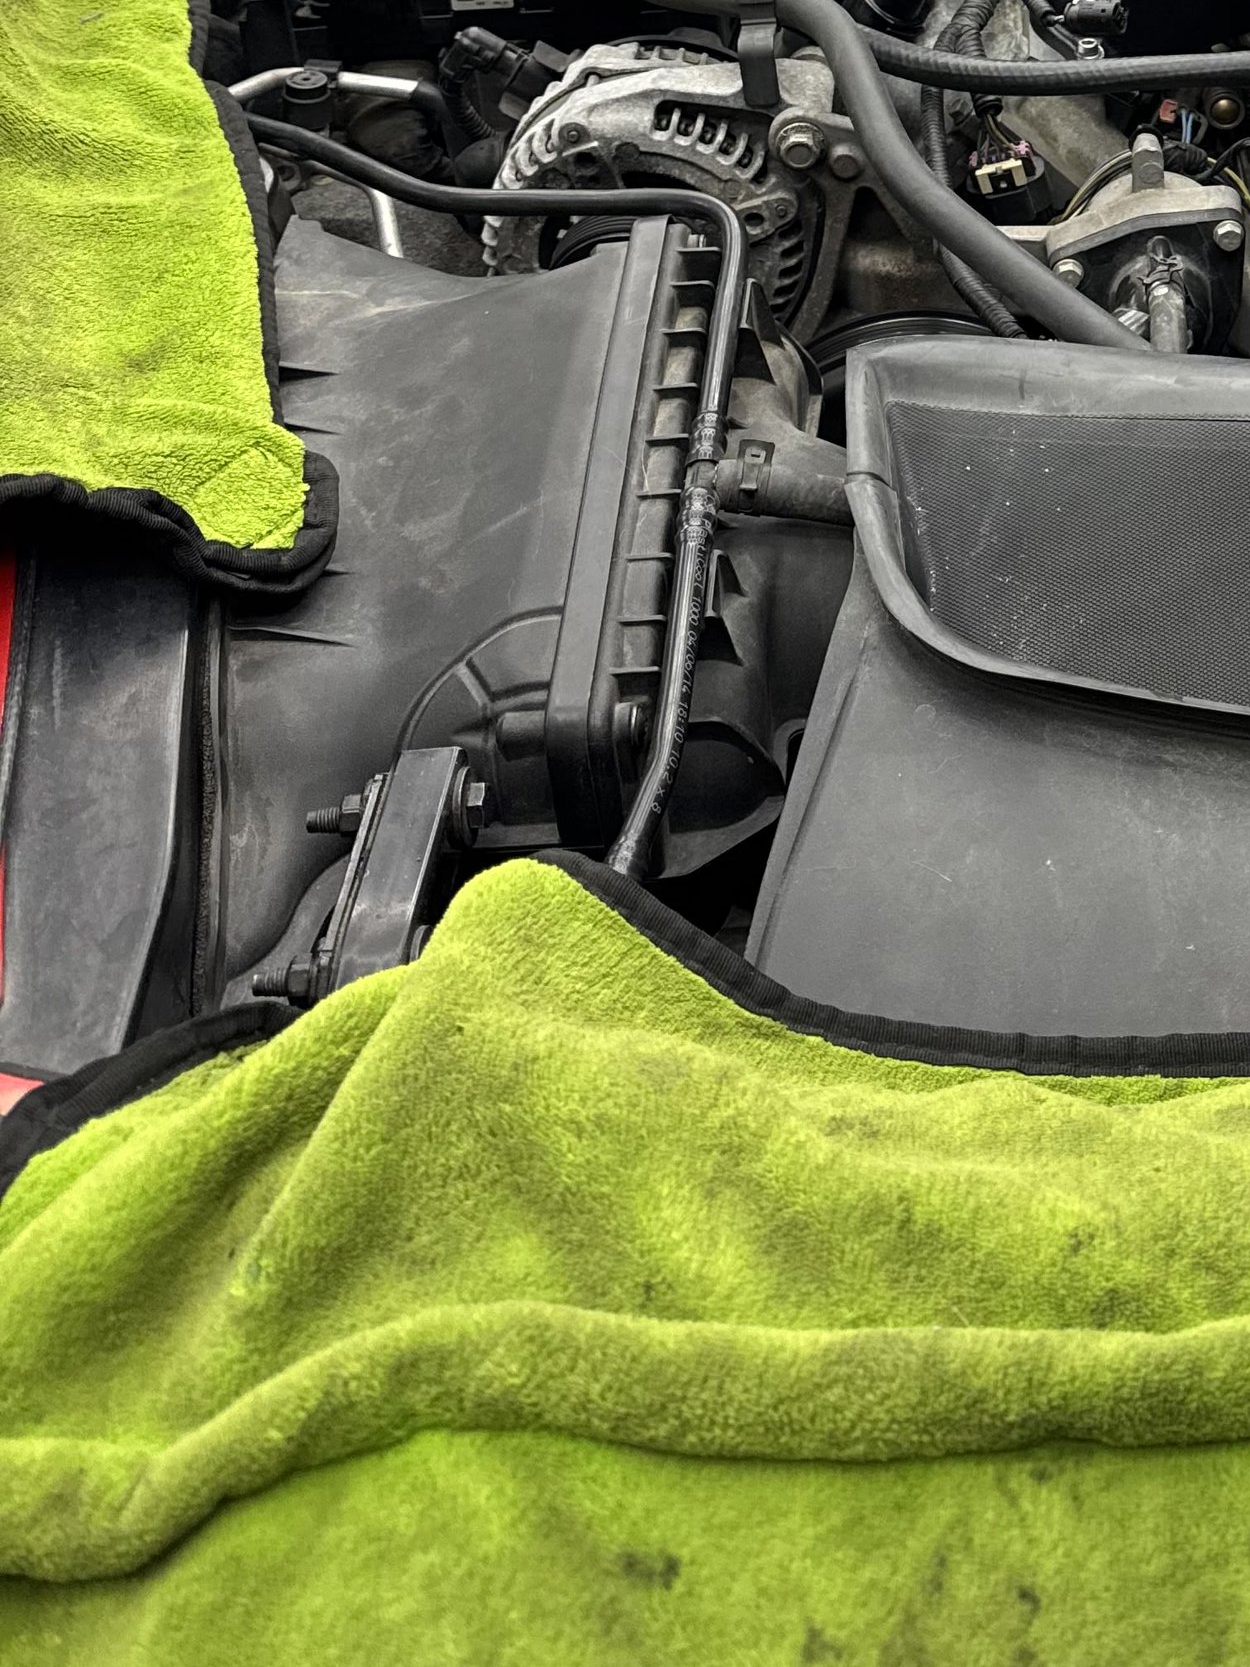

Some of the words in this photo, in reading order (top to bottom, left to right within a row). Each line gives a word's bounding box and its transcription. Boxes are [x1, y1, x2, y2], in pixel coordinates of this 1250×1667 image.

[689, 596, 702, 626] 1000
[662, 750, 681, 785] 10.2
[650, 801, 662, 815] 8
